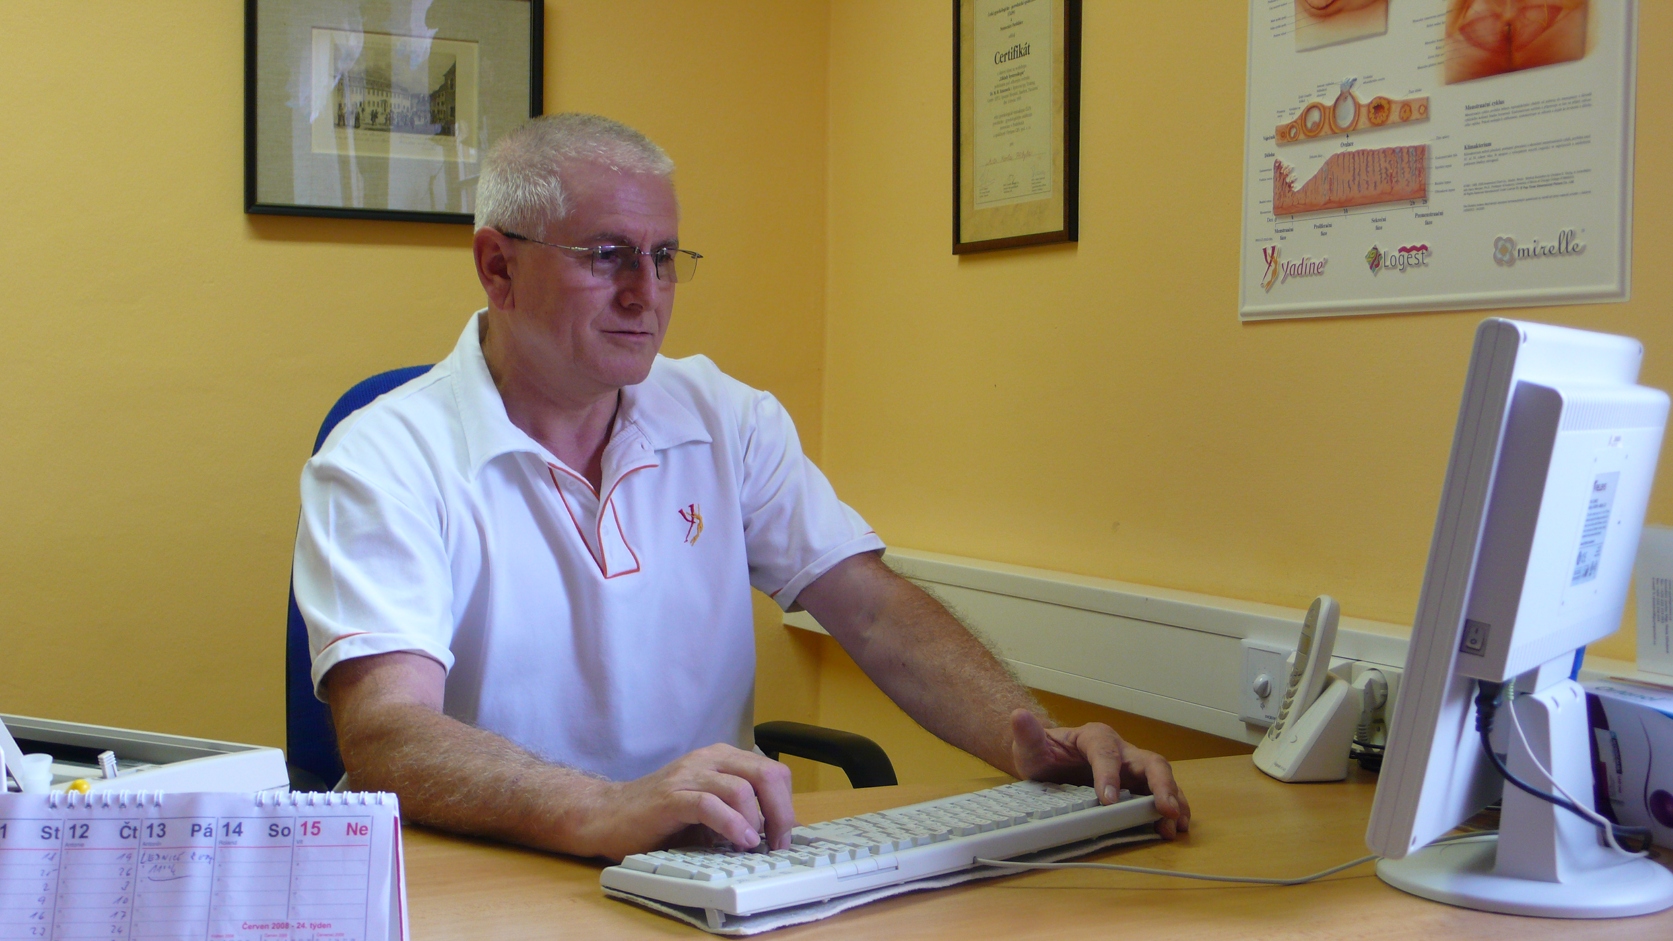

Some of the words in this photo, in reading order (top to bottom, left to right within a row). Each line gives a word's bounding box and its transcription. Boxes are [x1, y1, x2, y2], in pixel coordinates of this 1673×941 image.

[994, 42, 1031, 65] Certifikát
[1517, 229, 1580, 258] mirelle
[1383, 250, 1426, 271] Logest
[41, 825, 61, 840] St
[69, 823, 90, 839] 12
[119, 821, 139, 840] Čt
[146, 822, 167, 838] 13
[190, 823, 213, 838] Pá
[222, 821, 244, 837] 14
[268, 823, 291, 838] So
[300, 821, 321, 836] 15
[346, 822, 369, 836] Ne
[242, 921, 269, 930] Červen
[271, 922, 290, 930] 2008
[310, 921, 331, 930] týden
